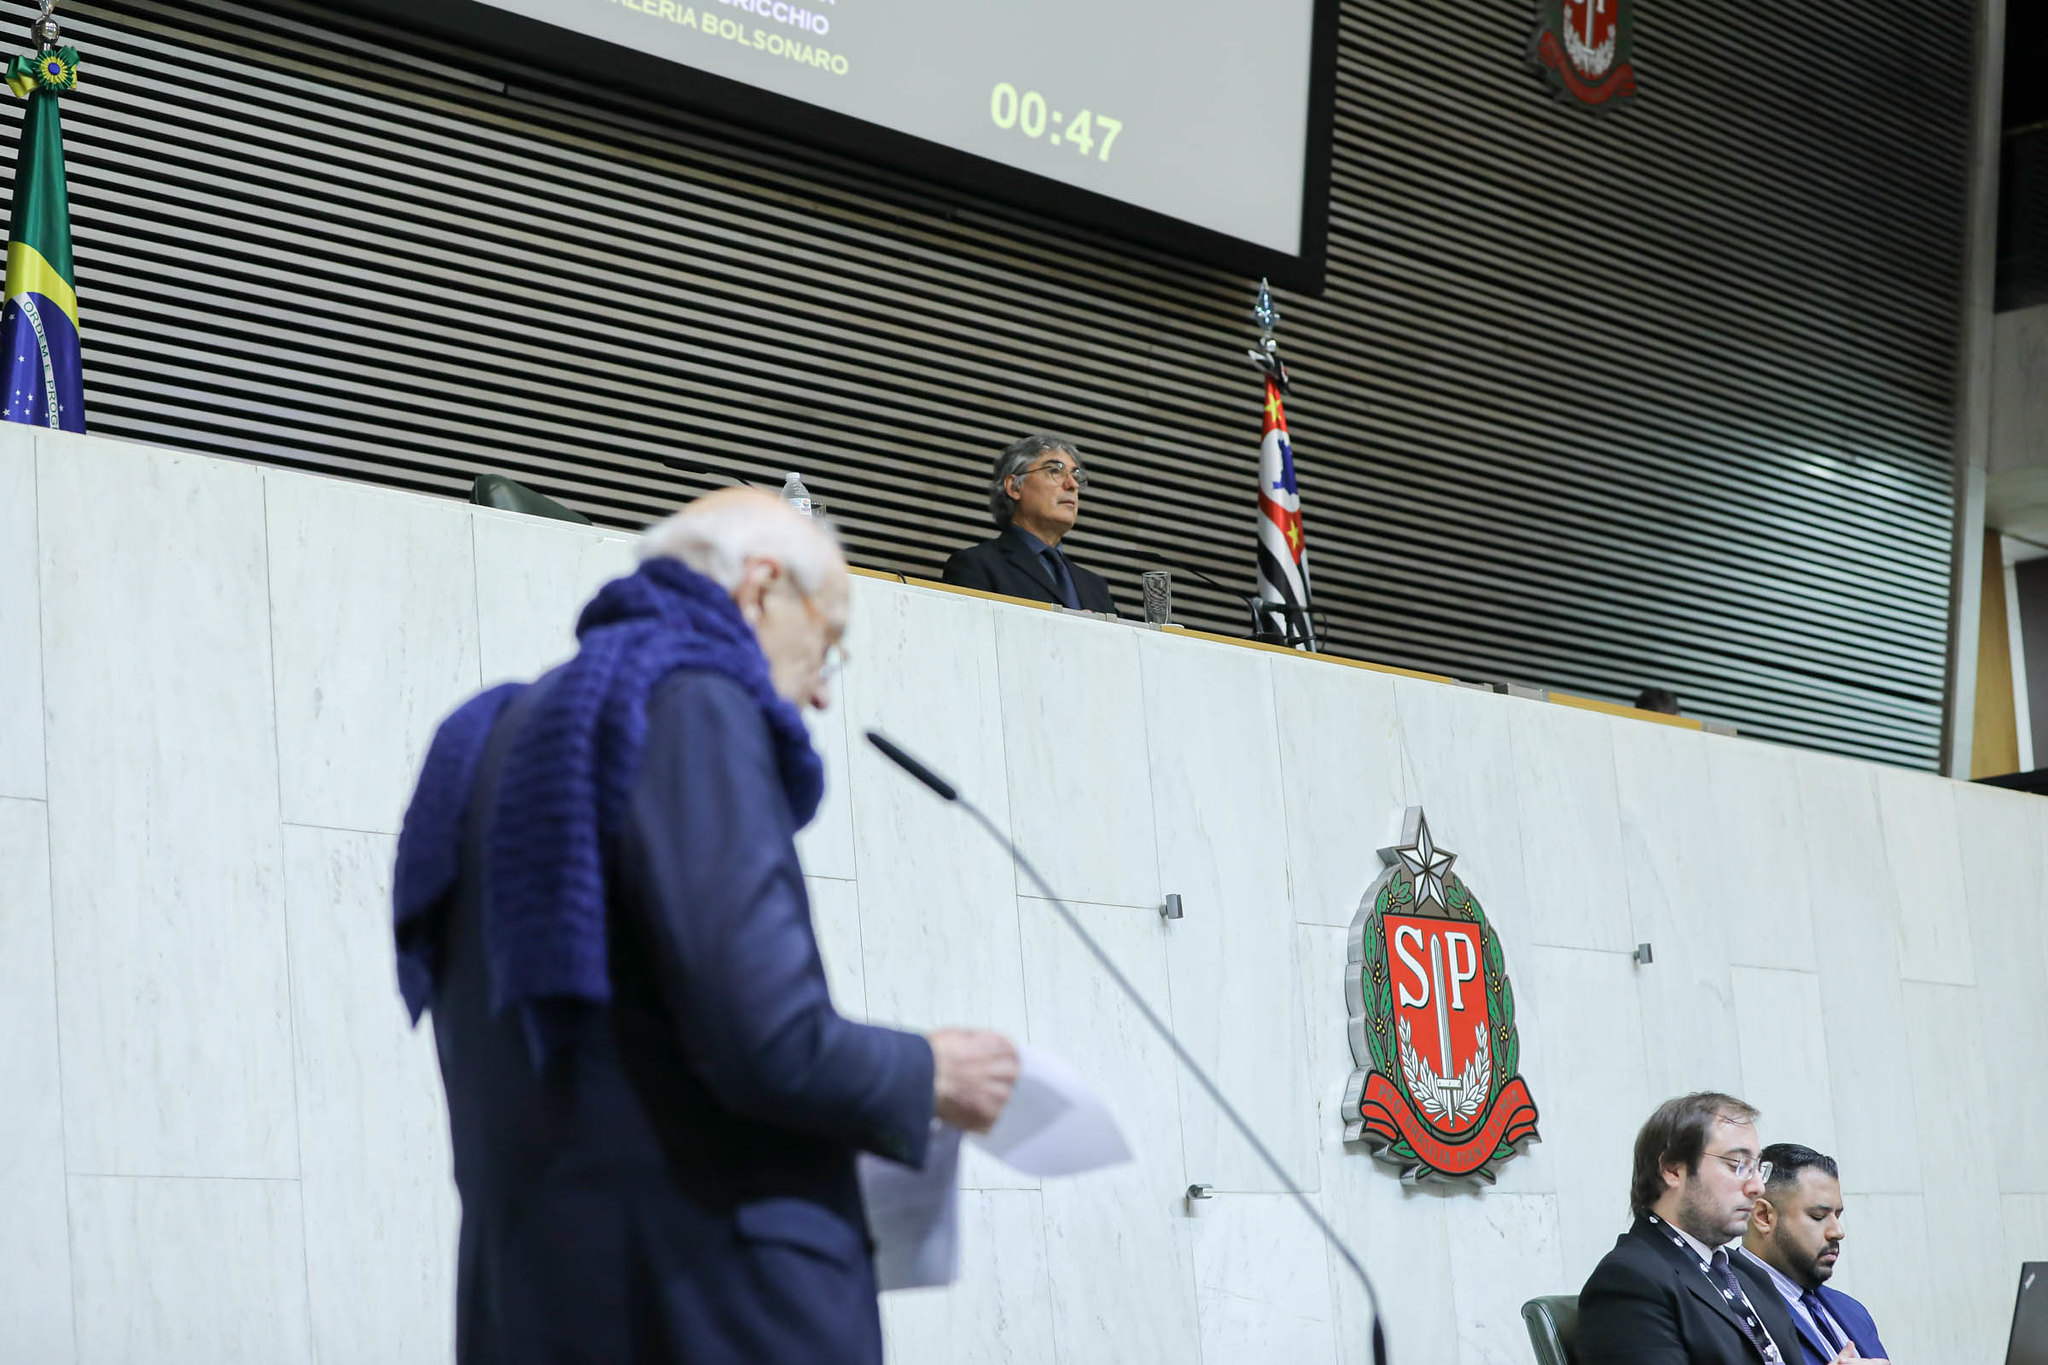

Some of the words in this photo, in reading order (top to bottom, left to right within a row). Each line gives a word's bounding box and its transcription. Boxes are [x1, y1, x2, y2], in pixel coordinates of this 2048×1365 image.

[611, 0, 698, 29] LERIA
[701, 12, 849, 75] BOLSONARO
[718, 0, 830, 36] RICCHIO
[990, 82, 1123, 162] 00:47
[23, 301, 49, 358] ORDEM
[1378, 1084, 1402, 1115] PRO
[1404, 1114, 1451, 1166] BRASILIA
[1457, 1138, 1487, 1167] FIANT
[1488, 1089, 1520, 1139] EXIMIA
